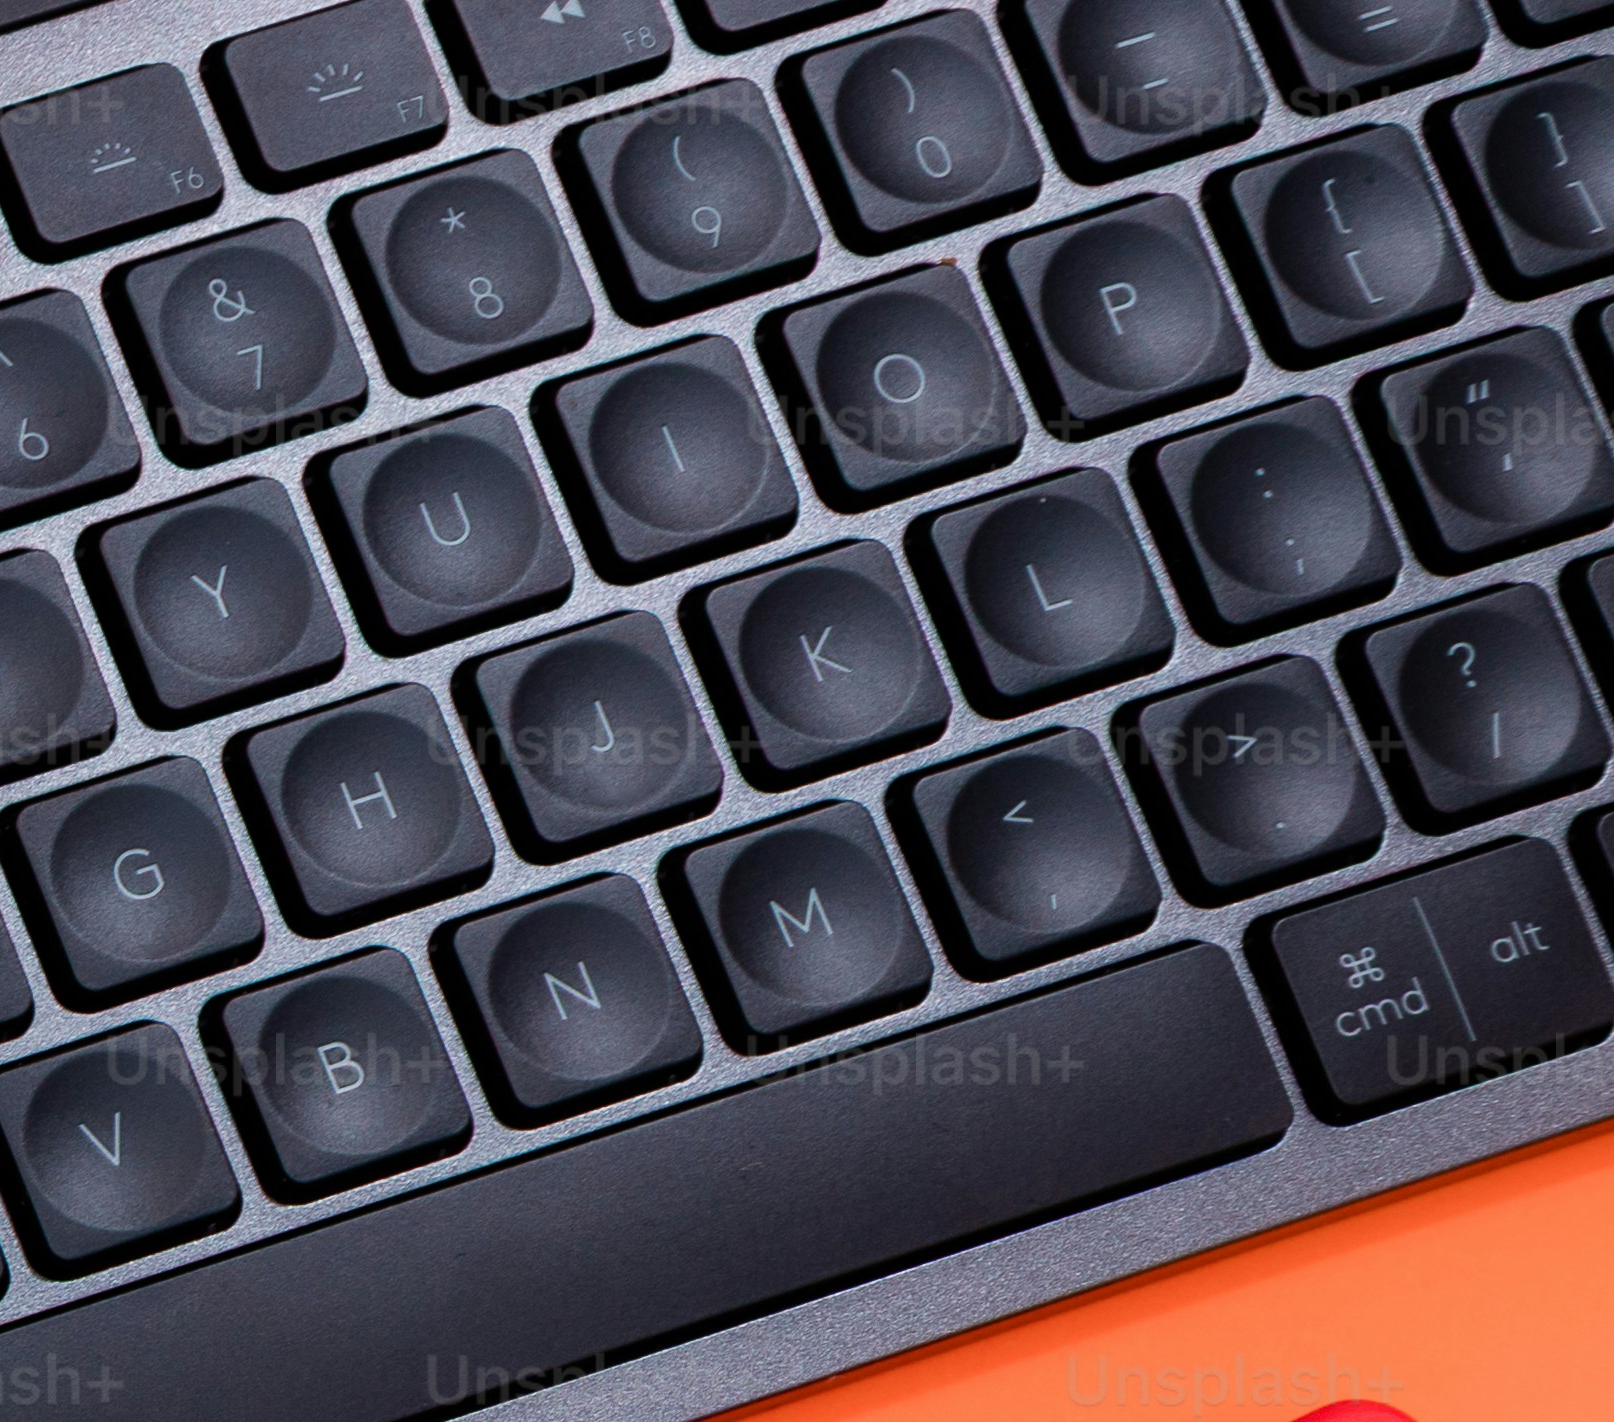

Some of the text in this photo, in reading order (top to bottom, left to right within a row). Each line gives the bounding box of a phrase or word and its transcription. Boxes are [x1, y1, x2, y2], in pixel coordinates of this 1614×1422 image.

[621, 25, 657, 54] F8
[396, 95, 424, 123] F7
[169, 166, 204, 194] F6
[691, 206, 722, 247] 9
[208, 278, 255, 323] &
[468, 276, 504, 319] 8
[1100, 282, 1137, 335] P
[236, 344, 263, 389] 7
[17, 417, 49, 461] 6
[420, 492, 471, 547] U
[191, 566, 229, 618] Y
[1027, 565, 1074, 612] L
[800, 626, 853, 683] K
[1448, 641, 1477, 688] ?
[591, 701, 615, 754] J
[341, 772, 397, 830] H
[113, 848, 165, 902] G
[769, 888, 835, 949] M
[1491, 921, 1549, 963] alt
[544, 962, 602, 1021] N
[1335, 978, 1430, 1039] cmd
[317, 1042, 365, 1095] B
[79, 1112, 121, 1167] V
